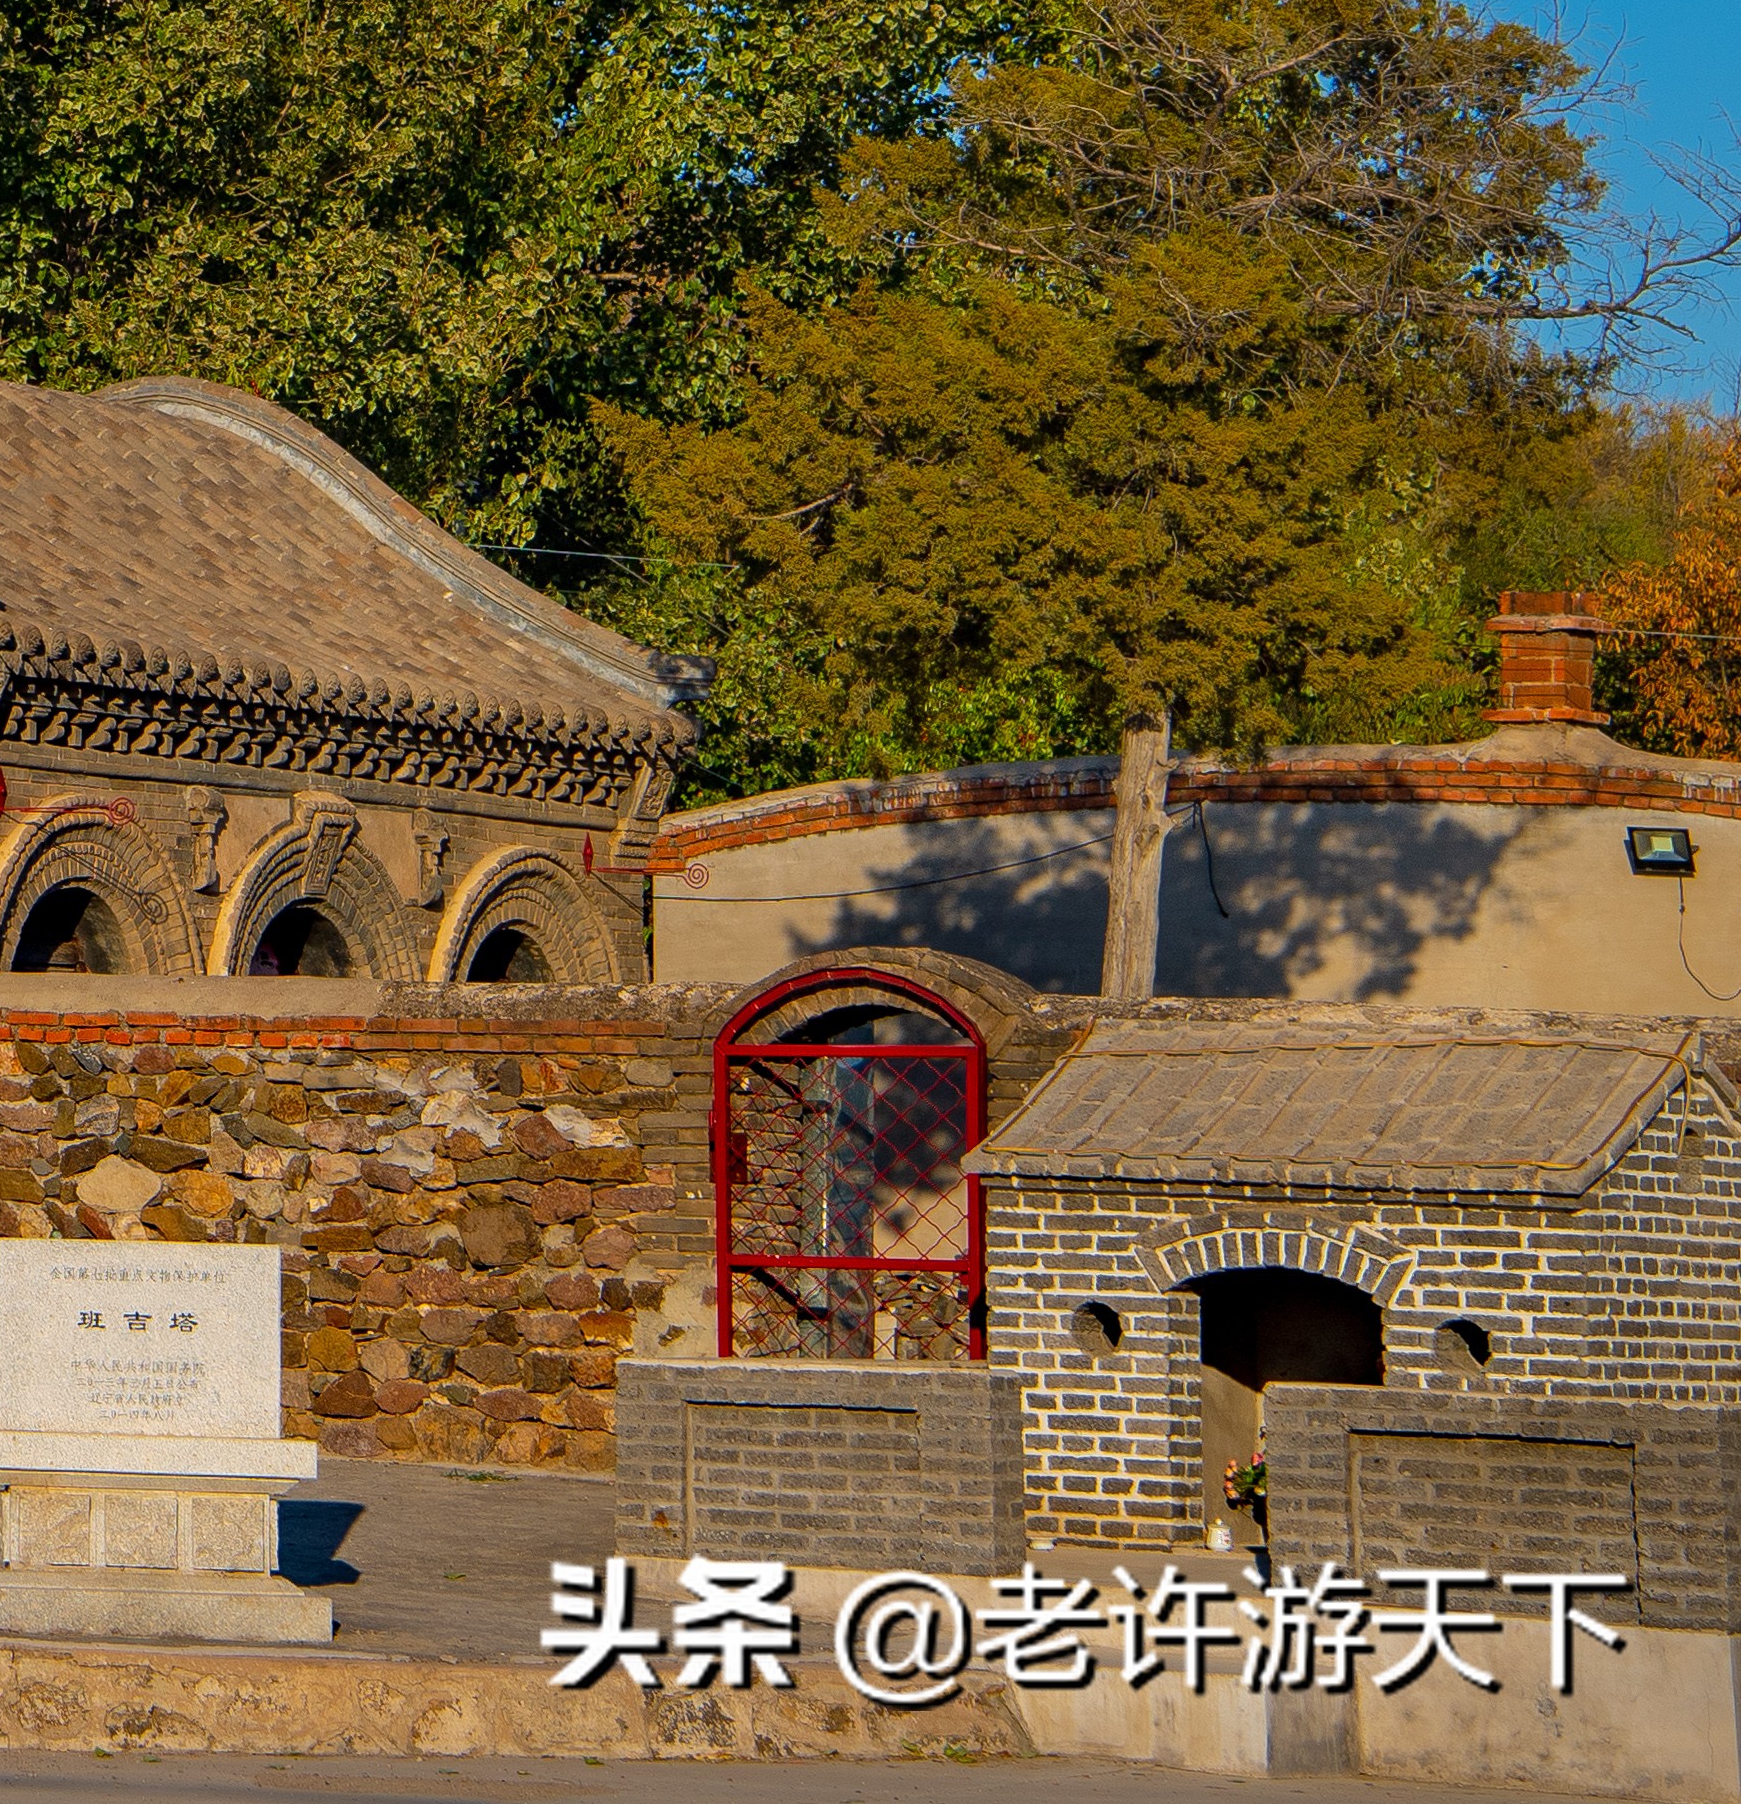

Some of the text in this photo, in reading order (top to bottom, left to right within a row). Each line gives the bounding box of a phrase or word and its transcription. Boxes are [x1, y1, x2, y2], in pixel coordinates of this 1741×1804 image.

[50, 1265, 227, 1285] 全国第七批重点文物保护单位
[77, 1310, 199, 1334] 班吉塔
